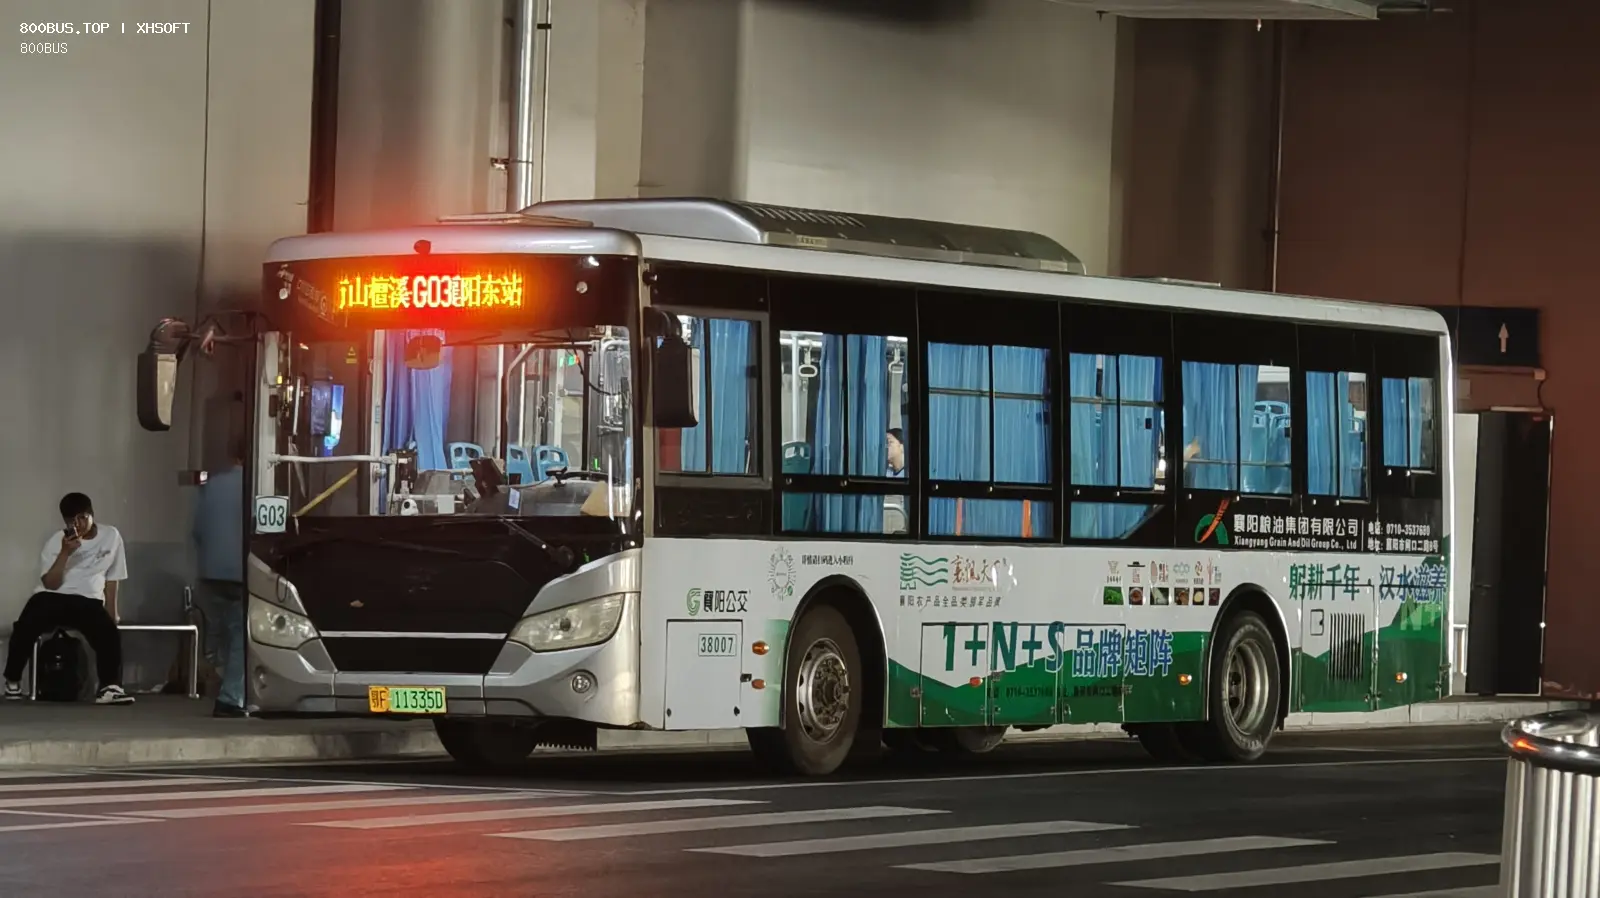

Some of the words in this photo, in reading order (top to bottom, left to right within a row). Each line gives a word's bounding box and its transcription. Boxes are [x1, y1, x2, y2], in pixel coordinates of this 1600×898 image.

[413, 275, 452, 308] G03
[257, 504, 285, 526] G03
[1233, 513, 1359, 537] 襄阳粮油集团有限公司
[1234, 535, 1268, 548] Xiangyang
[1269, 537, 1287, 547] Grain
[1288, 537, 1300, 547] And
[1301, 538, 1311, 548] Oil
[1311, 538, 1330, 550] Group
[1347, 540, 1357, 549] Ltd
[703, 590, 748, 612] 襄阳公交
[700, 636, 734, 653] 38007
[943, 621, 1065, 673] 1+N+S
[1071, 628, 1175, 678] 品牌矩阵
[395, 690, 443, 709] 11335D
